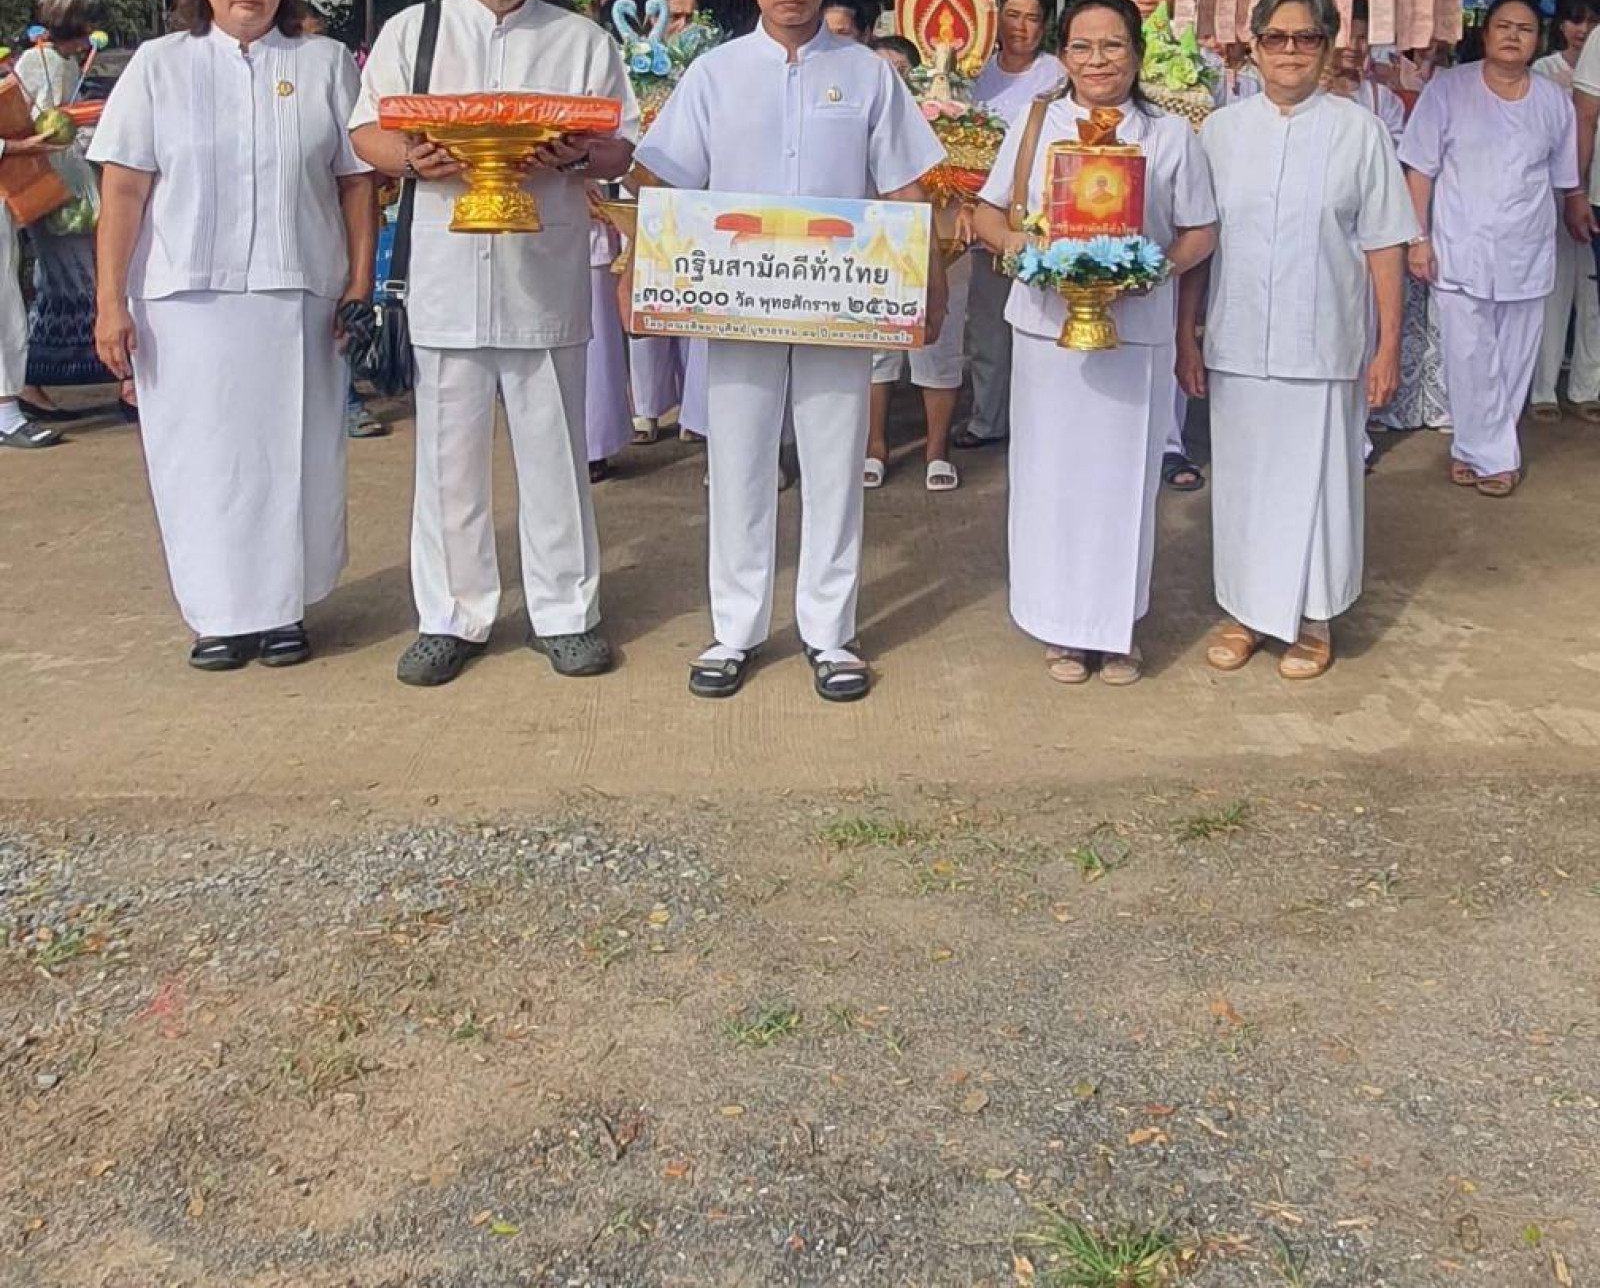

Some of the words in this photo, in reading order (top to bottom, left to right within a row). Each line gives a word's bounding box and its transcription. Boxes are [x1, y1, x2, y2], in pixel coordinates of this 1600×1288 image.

[674, 249, 889, 284] กฐินสามัคคีทั่วไทย
[643, 286, 729, 306] ๓๐,๐๐๐
[735, 290, 755, 308] วัด
[759, 294, 841, 314] พุทธศักราช
[848, 296, 918, 316] ๒๕๖๘
